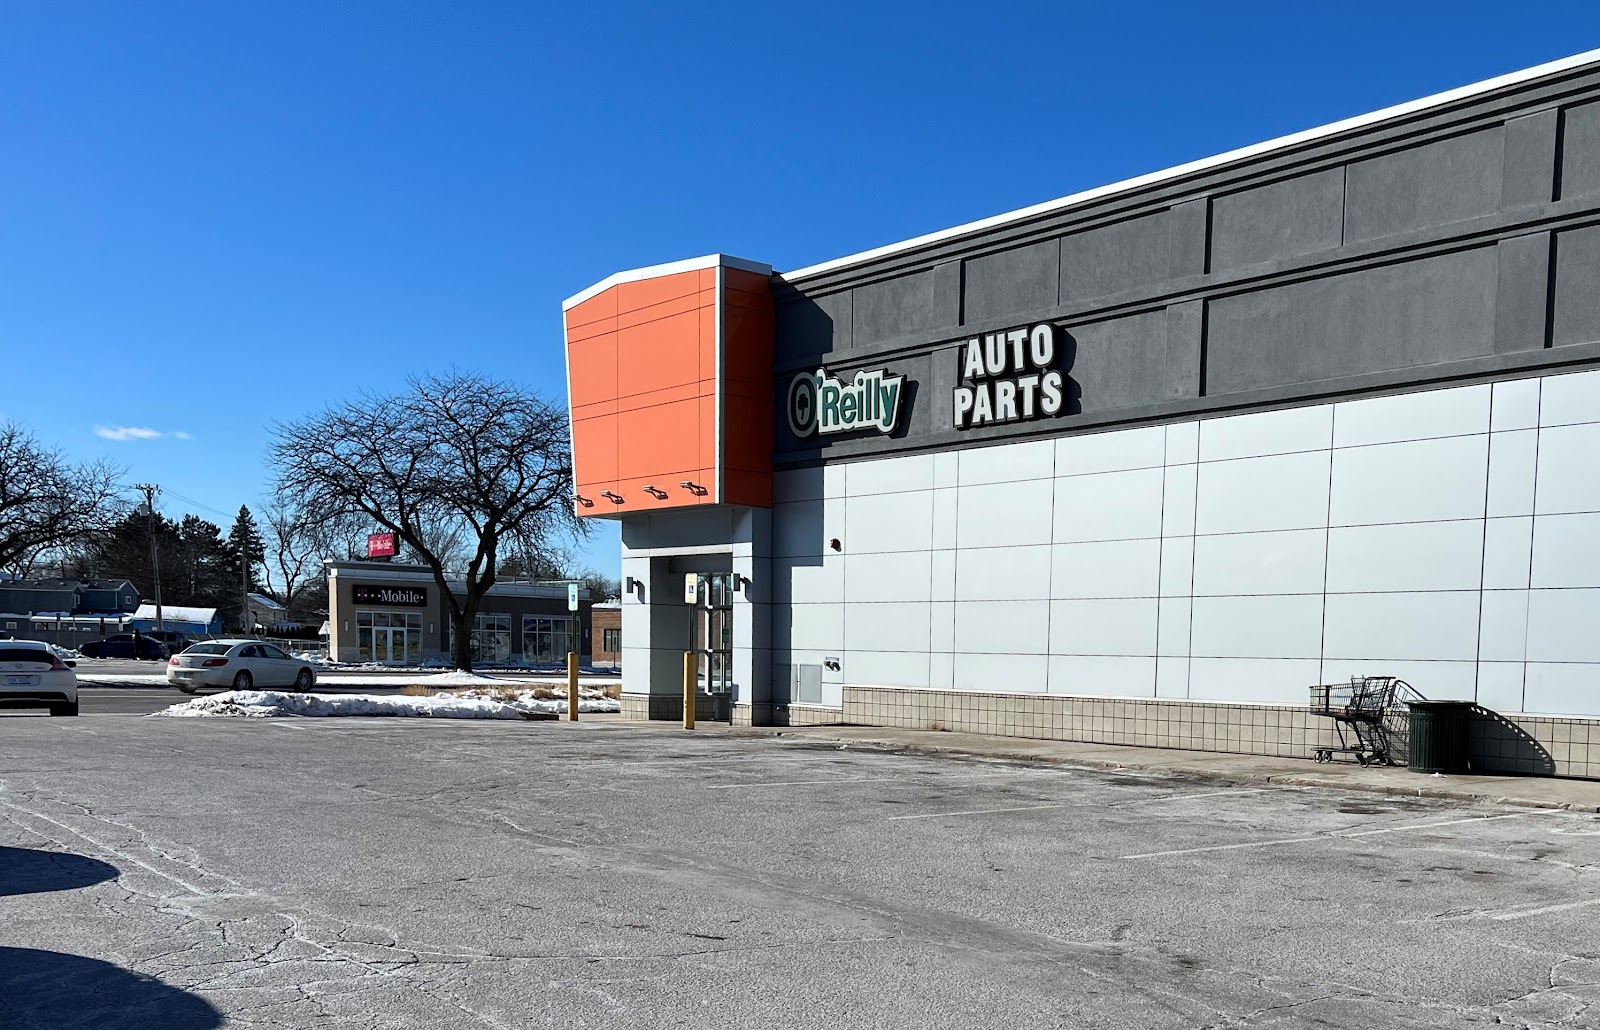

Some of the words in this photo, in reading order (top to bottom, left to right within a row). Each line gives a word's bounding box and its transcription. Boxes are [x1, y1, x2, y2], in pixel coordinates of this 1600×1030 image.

[964, 324, 1054, 378] AUTO
[787, 368, 901, 438] O'Reilly
[953, 371, 1063, 426] PARTS
